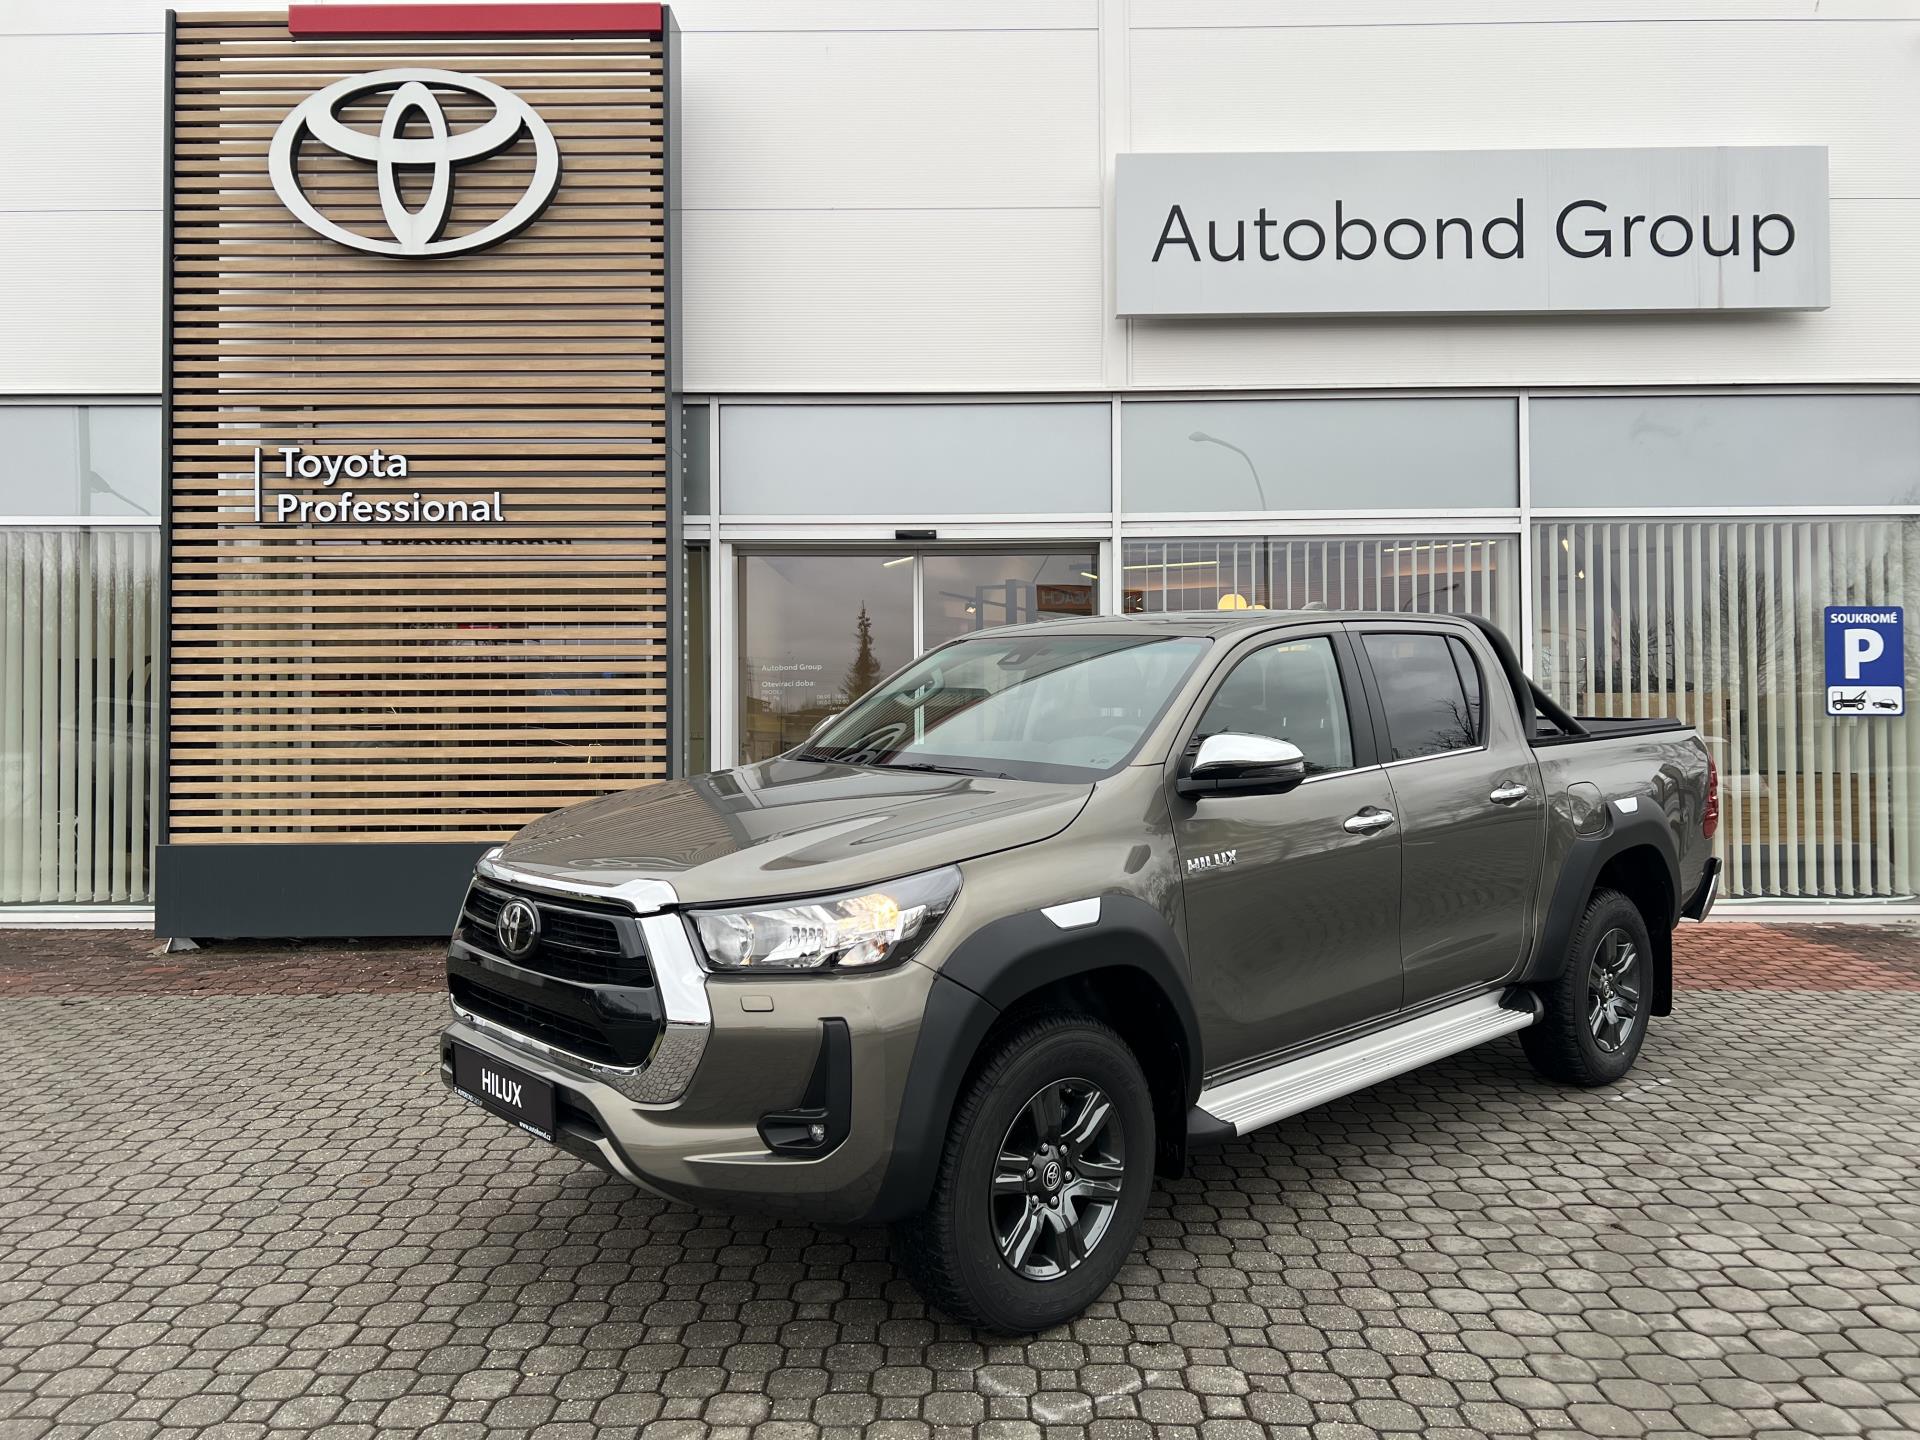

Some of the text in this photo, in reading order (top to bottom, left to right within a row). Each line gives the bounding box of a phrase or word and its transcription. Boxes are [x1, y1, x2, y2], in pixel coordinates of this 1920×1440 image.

[1151, 197, 1796, 272] Autobond Group
[277, 447, 408, 486] Toyota
[277, 491, 504, 523] Professional
[1831, 612, 1897, 623] SOUKROMÉ
[799, 663, 823, 672] Group
[1845, 629, 1884, 679] P
[1187, 849, 1237, 871] HILUX
[482, 1068, 522, 1108] HILUX
